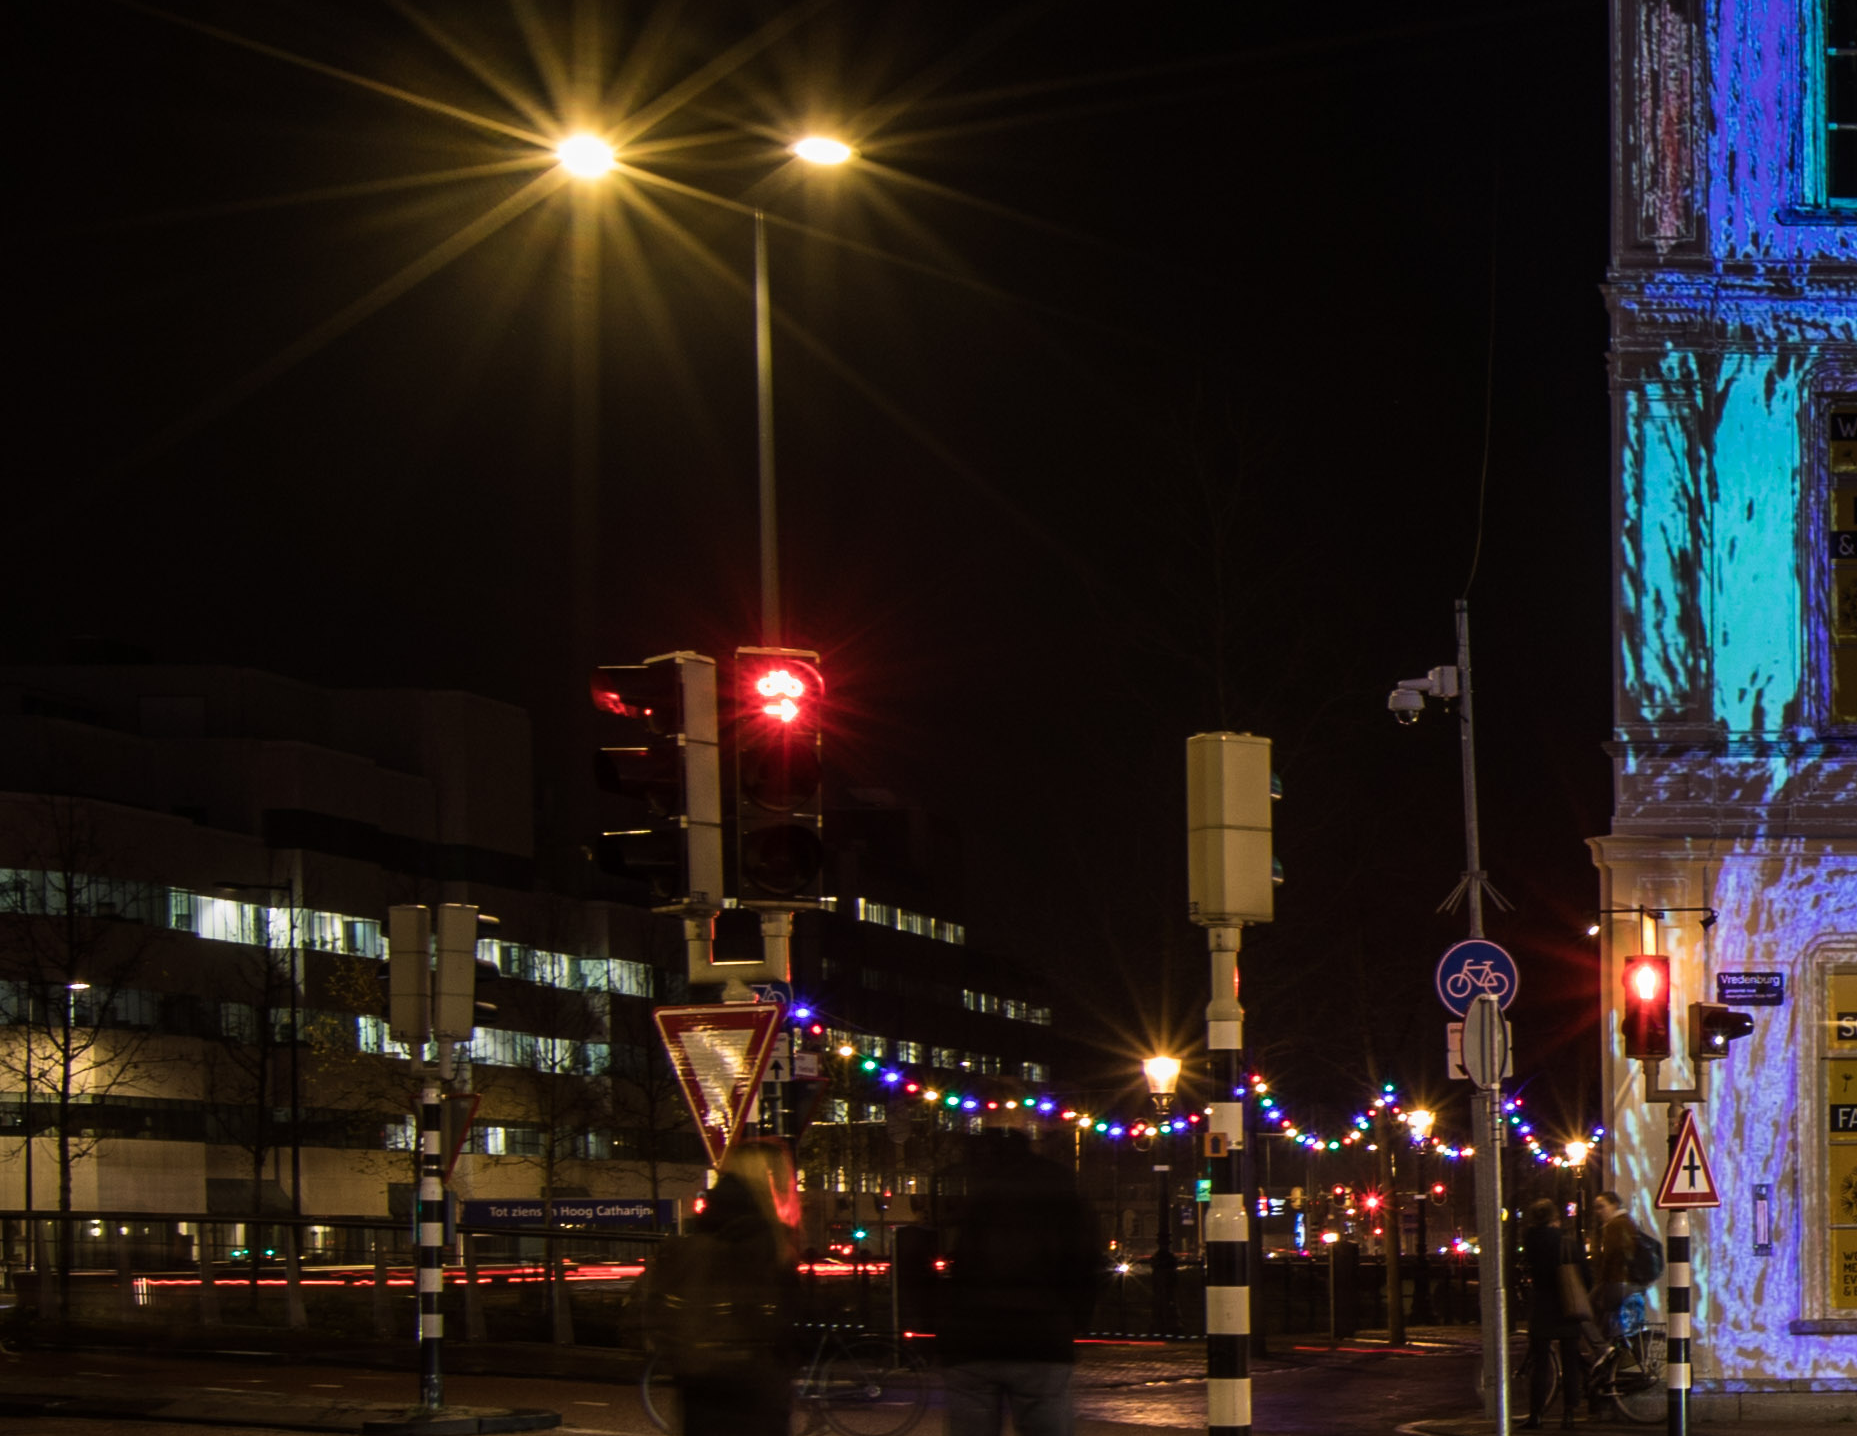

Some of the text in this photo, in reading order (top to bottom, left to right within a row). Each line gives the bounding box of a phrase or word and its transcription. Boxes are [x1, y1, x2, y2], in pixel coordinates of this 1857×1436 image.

[1838, 533, 1855, 556] &
[1720, 974, 1780, 986] Vredenburg
[489, 1206, 508, 1218] Tot
[511, 1206, 543, 1218] ziens
[560, 1206, 594, 1219] Hoog
[1843, 1286, 1852, 1296] &
